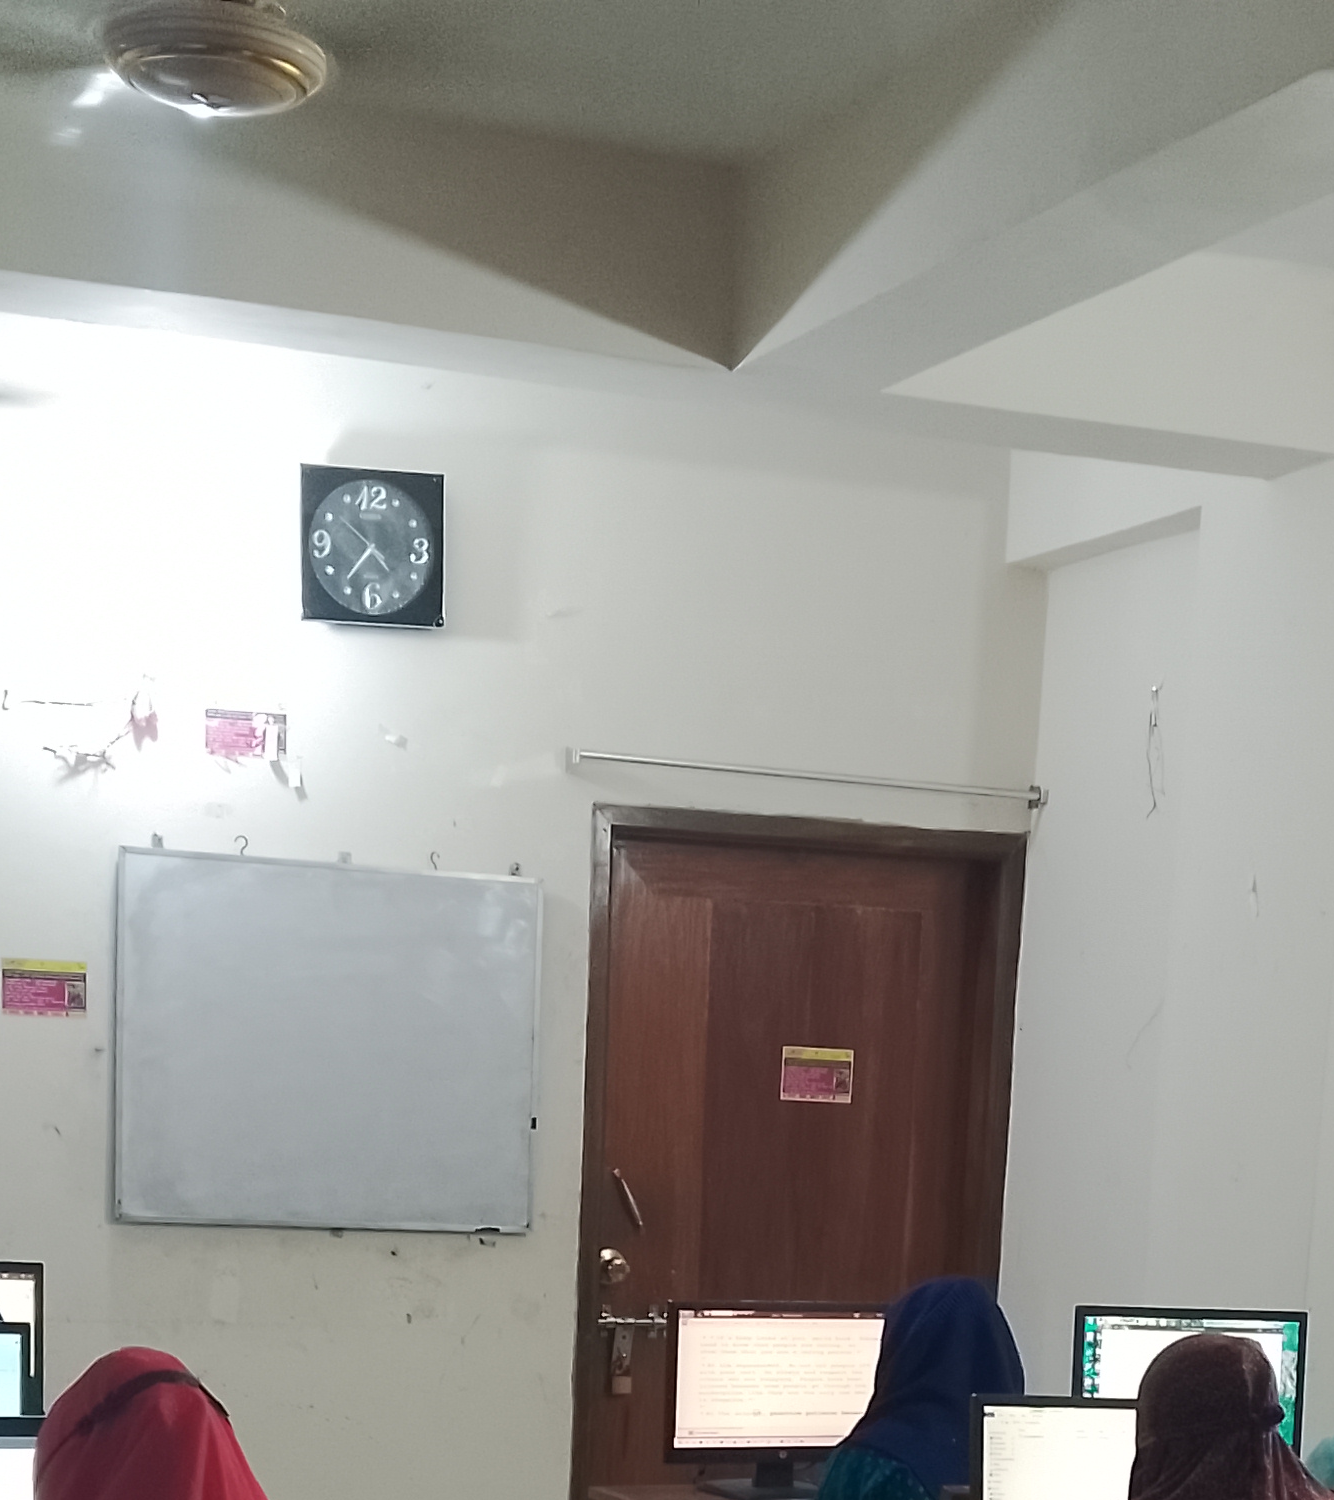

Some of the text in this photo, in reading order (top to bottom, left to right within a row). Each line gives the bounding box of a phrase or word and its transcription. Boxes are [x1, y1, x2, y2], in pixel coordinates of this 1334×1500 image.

[355, 485, 387, 511] 12
[311, 529, 429, 564] 9 3
[363, 582, 383, 610] 6
